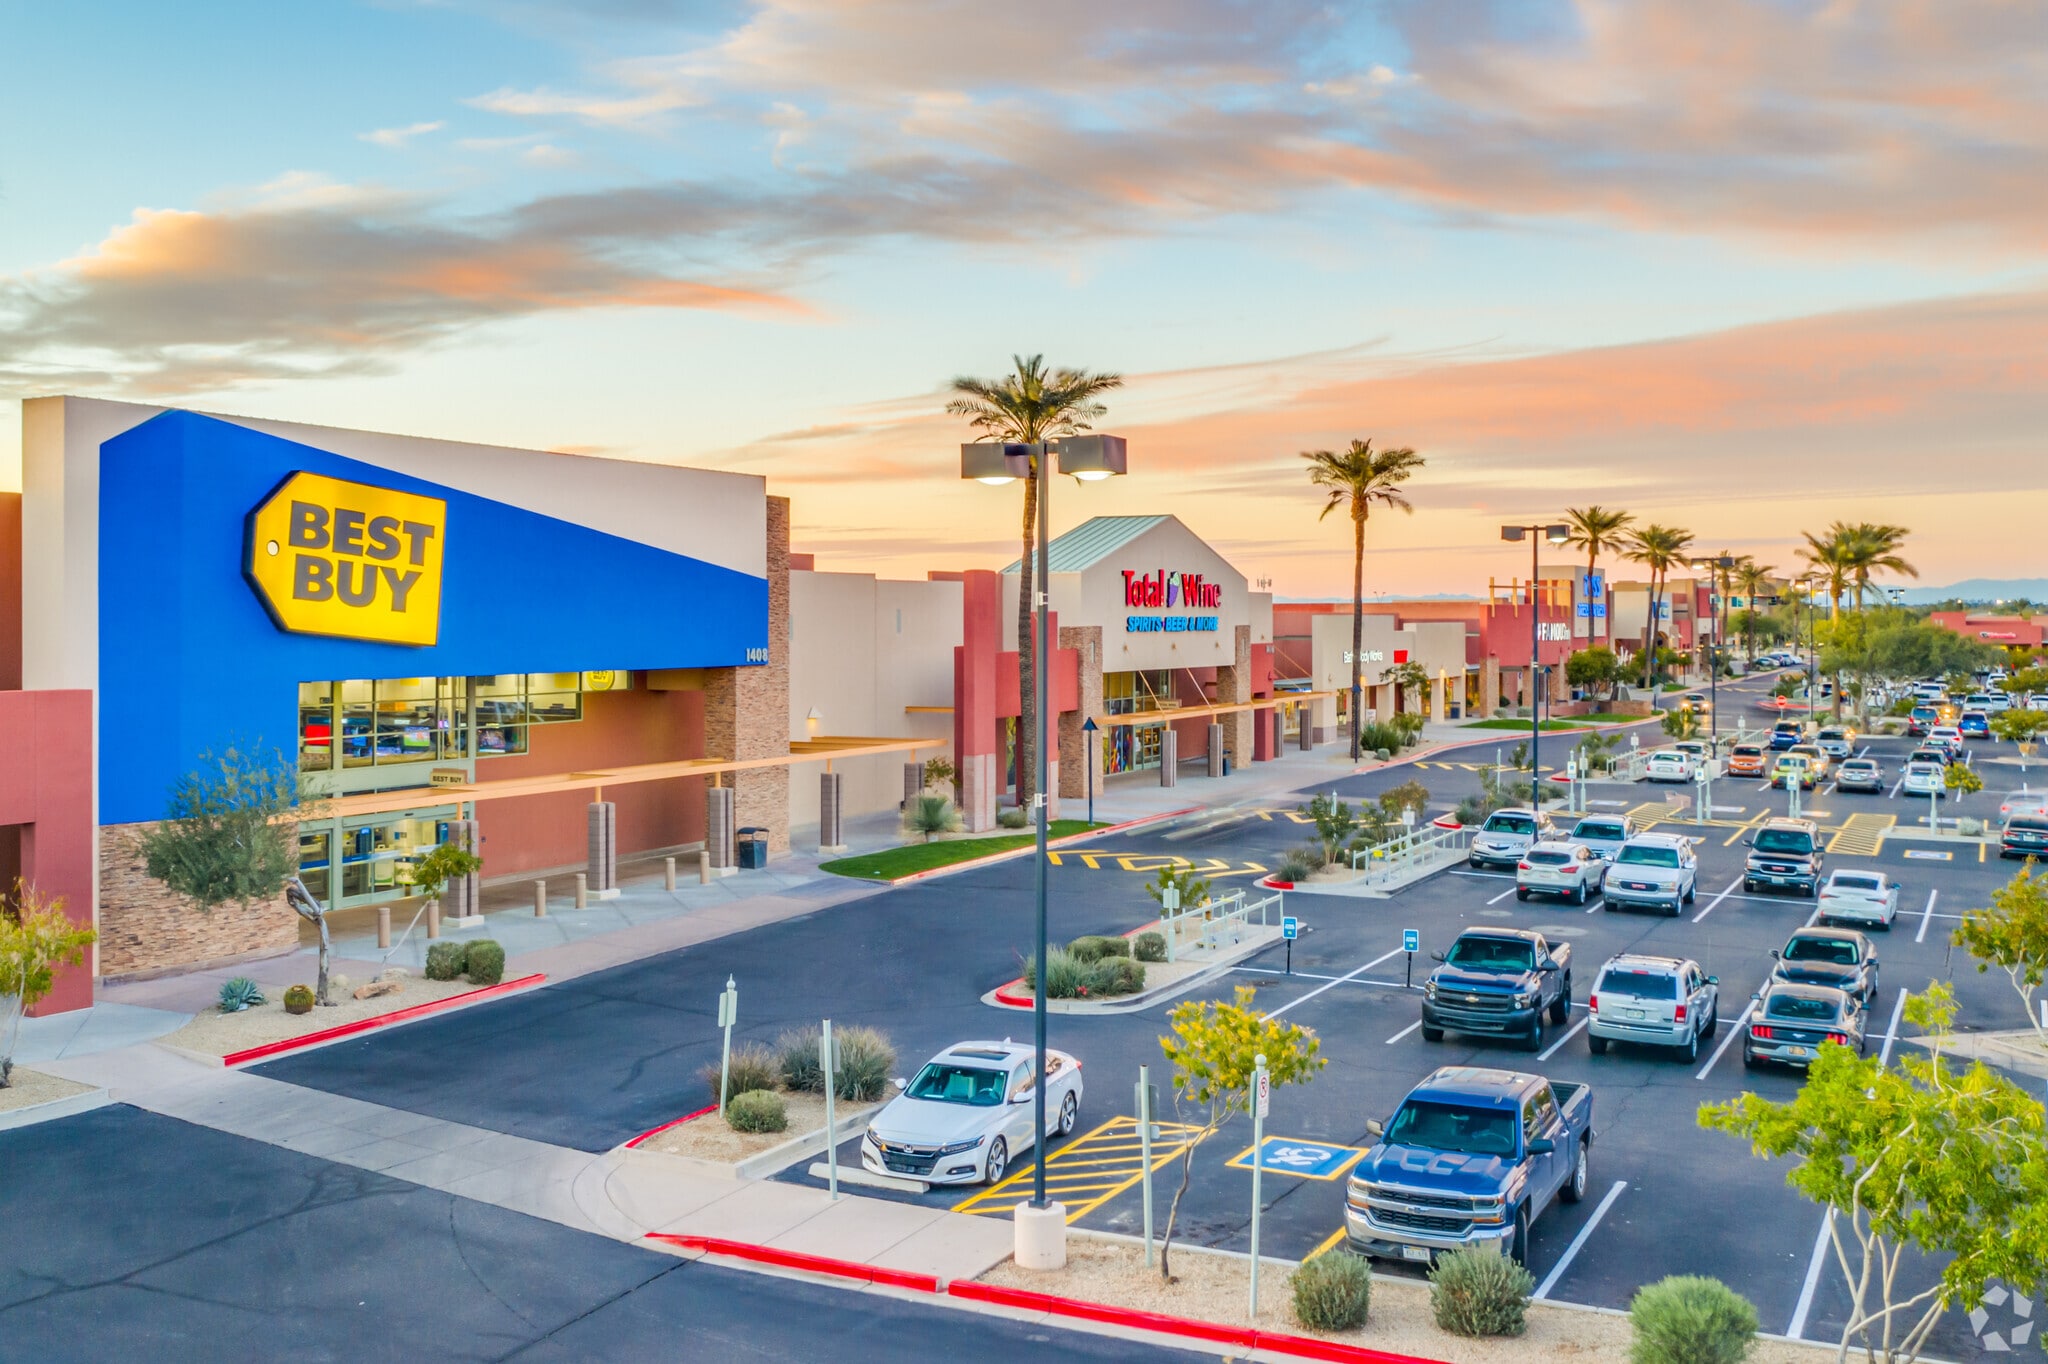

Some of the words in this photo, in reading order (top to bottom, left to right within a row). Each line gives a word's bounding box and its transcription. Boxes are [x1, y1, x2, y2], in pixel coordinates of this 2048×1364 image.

[288, 499, 435, 567] BEST
[292, 553, 424, 613] BUY
[1121, 568, 1165, 608] Total
[1181, 573, 1222, 608] Wine
[1164, 616, 1187, 632] BEER
[1187, 616, 1195, 632] &
[1195, 616, 1219, 632] MORE
[746, 647, 768, 662] 1408
[432, 775, 448, 783] BEST
